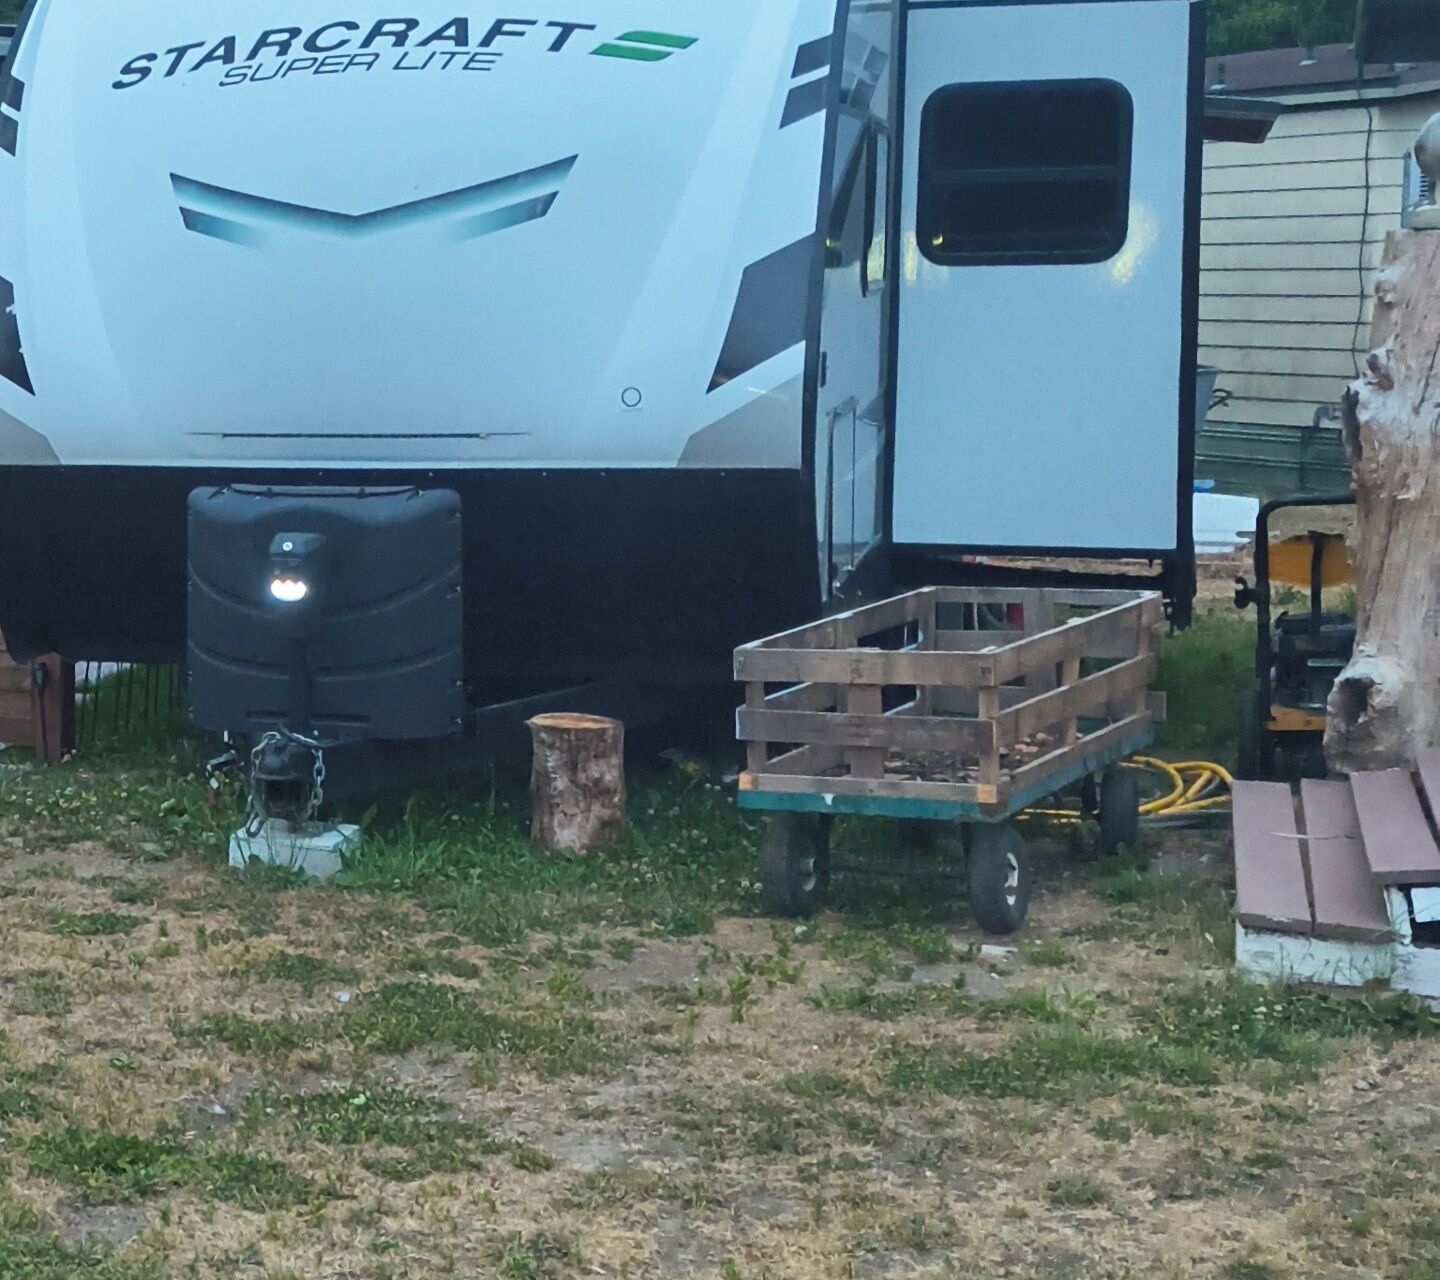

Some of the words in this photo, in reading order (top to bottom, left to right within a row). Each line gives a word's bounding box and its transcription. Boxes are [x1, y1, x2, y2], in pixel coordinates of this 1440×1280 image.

[112, 17, 596, 89] STARCRAFT
[218, 52, 380, 87] SUPER
[392, 51, 503, 72] LITE
